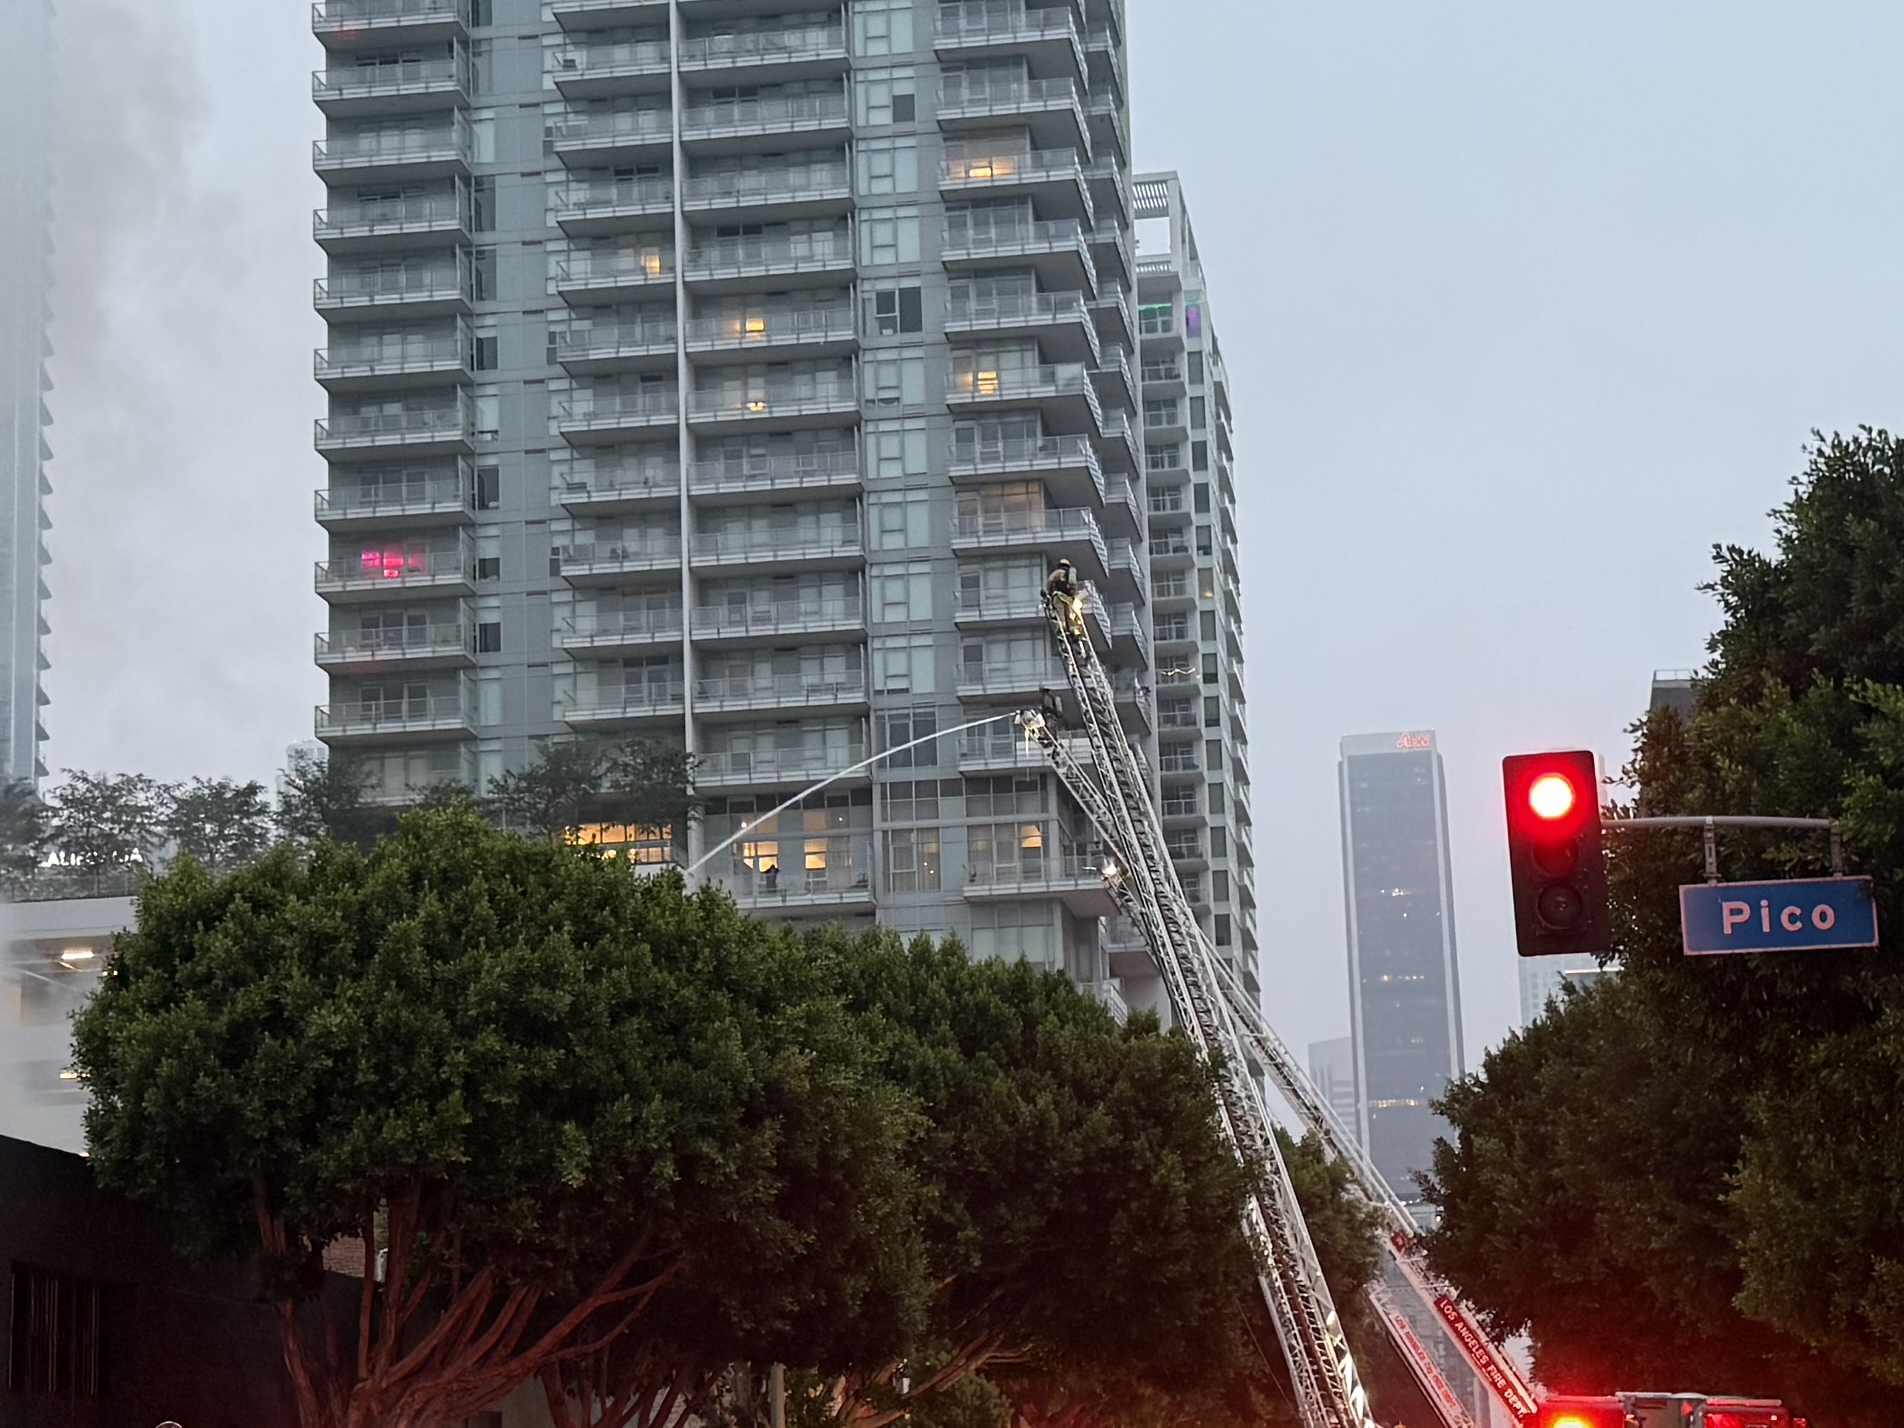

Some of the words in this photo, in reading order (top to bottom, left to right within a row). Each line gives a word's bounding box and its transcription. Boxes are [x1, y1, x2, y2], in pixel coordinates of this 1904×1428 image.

[1722, 899, 1835, 935] Pico
[1439, 1300, 1457, 1321] LOS
[1455, 1322, 1489, 1365] ANGELES
[1487, 1363, 1505, 1389] FIRE
